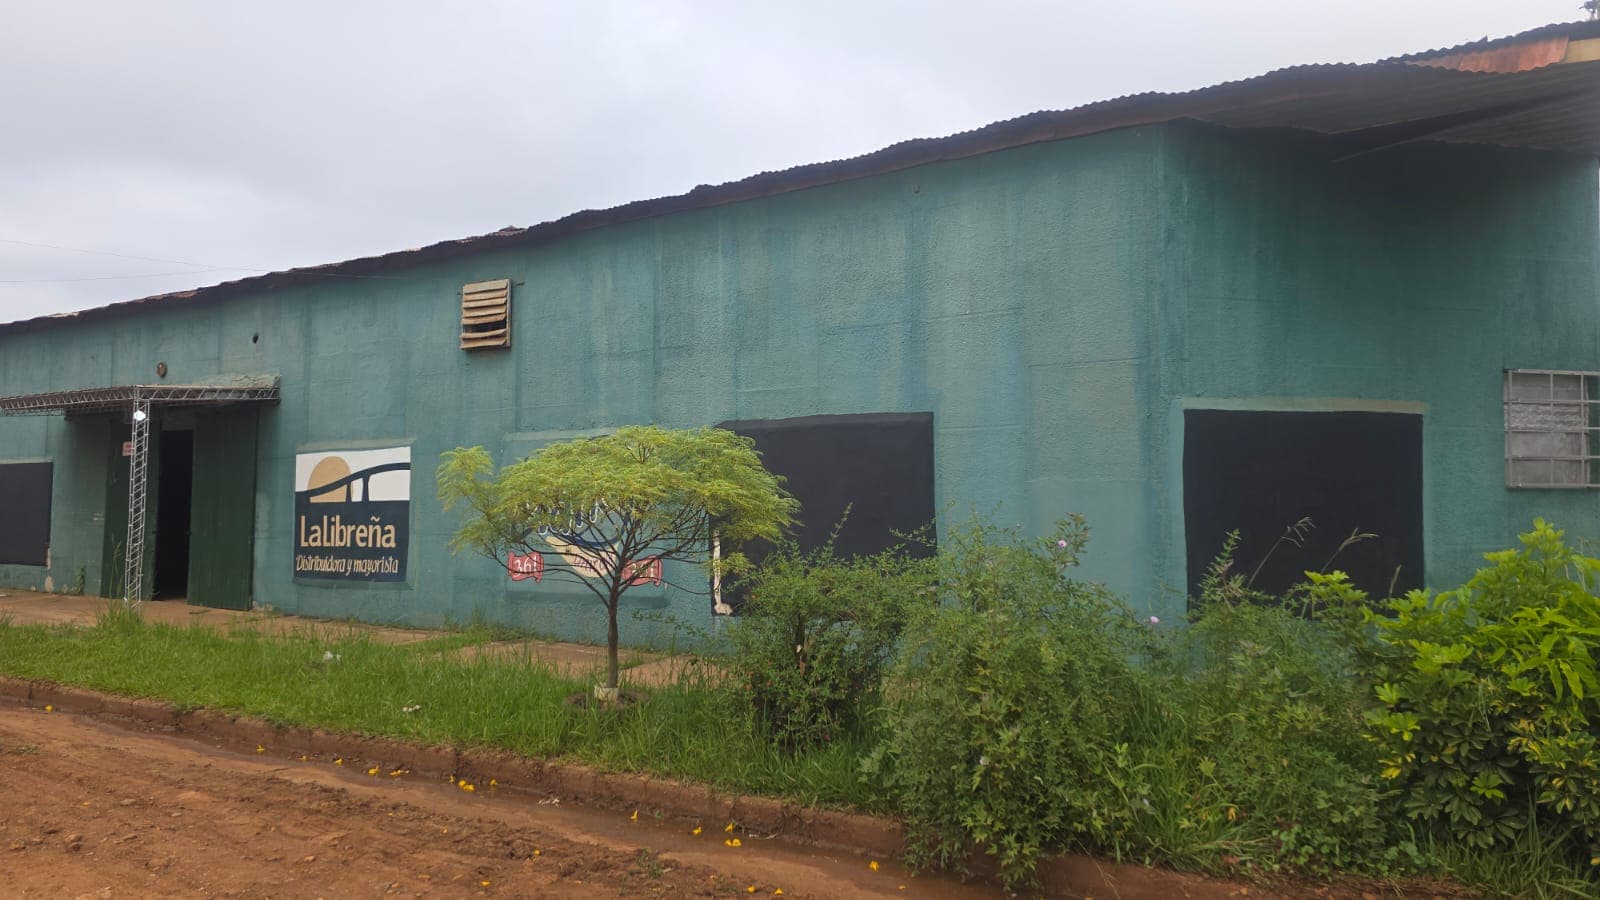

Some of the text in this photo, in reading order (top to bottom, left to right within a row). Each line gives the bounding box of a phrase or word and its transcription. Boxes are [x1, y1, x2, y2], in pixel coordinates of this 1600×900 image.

[296, 554, 399, 577] Distribuidora y mayorista
